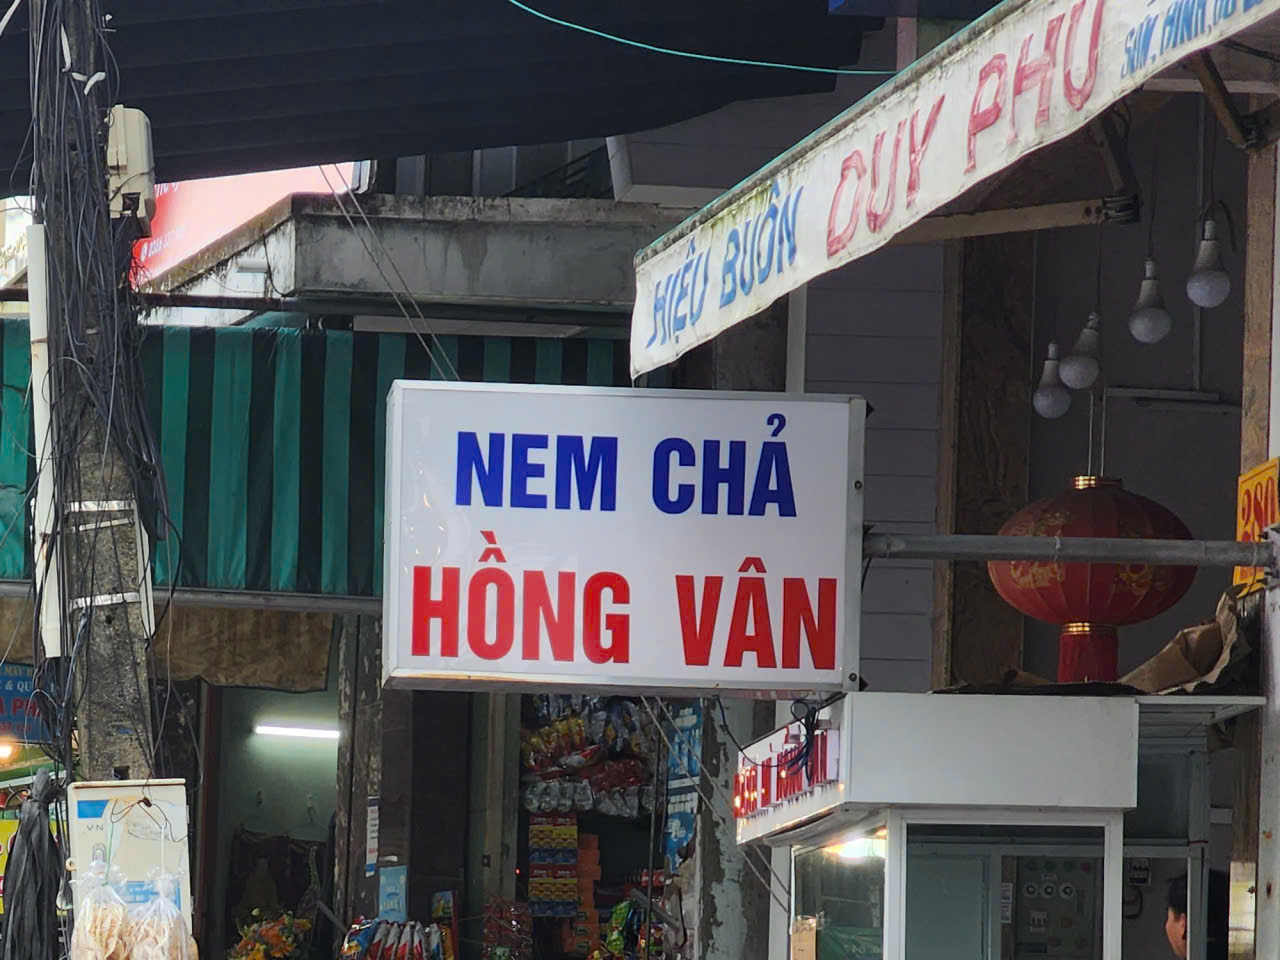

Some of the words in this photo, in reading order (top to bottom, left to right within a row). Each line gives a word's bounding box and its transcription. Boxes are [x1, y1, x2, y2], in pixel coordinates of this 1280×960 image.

[455, 430, 619, 512] NEM
[651, 412, 798, 518] CHẢ
[410, 529, 631, 665] HỒNG
[674, 556, 838, 671] VÂN
